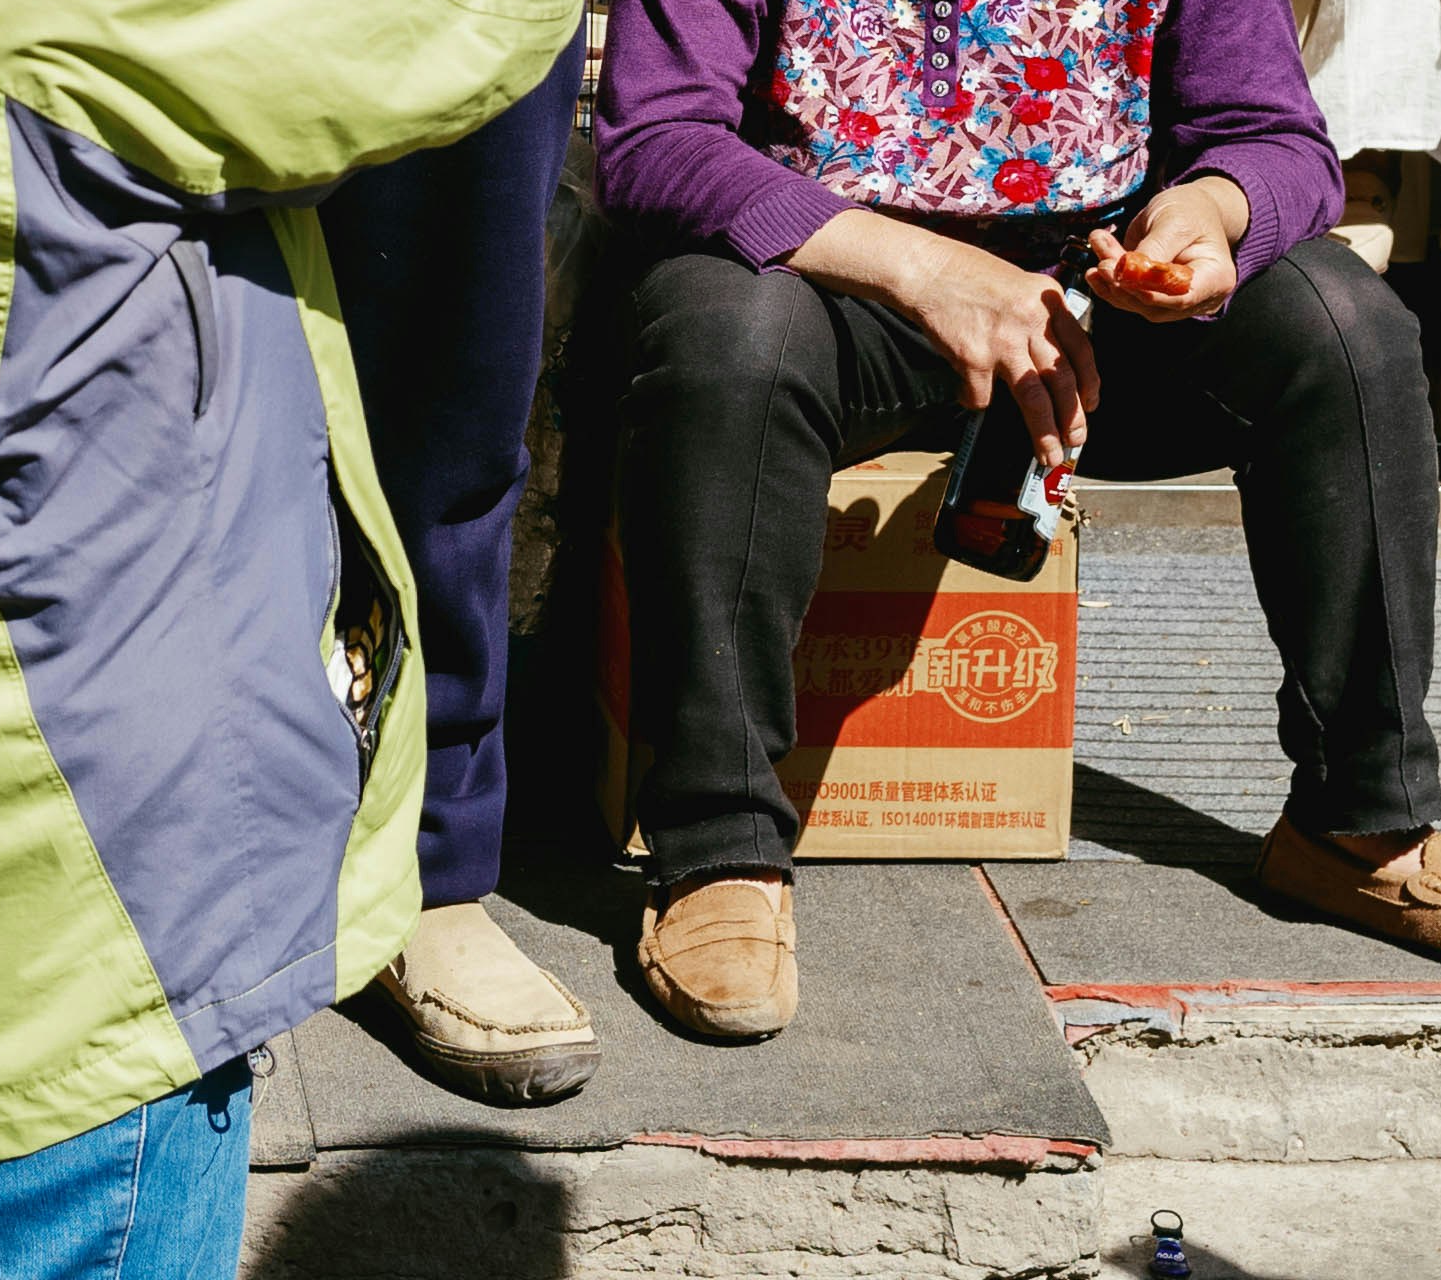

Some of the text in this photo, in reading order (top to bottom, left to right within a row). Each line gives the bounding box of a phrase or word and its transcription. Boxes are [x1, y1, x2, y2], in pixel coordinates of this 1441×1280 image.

[954, 618, 1033, 645] 氨基酸配方
[927, 646, 1053, 688] 新升级
[953, 687, 1029, 713] 温和不伤手
